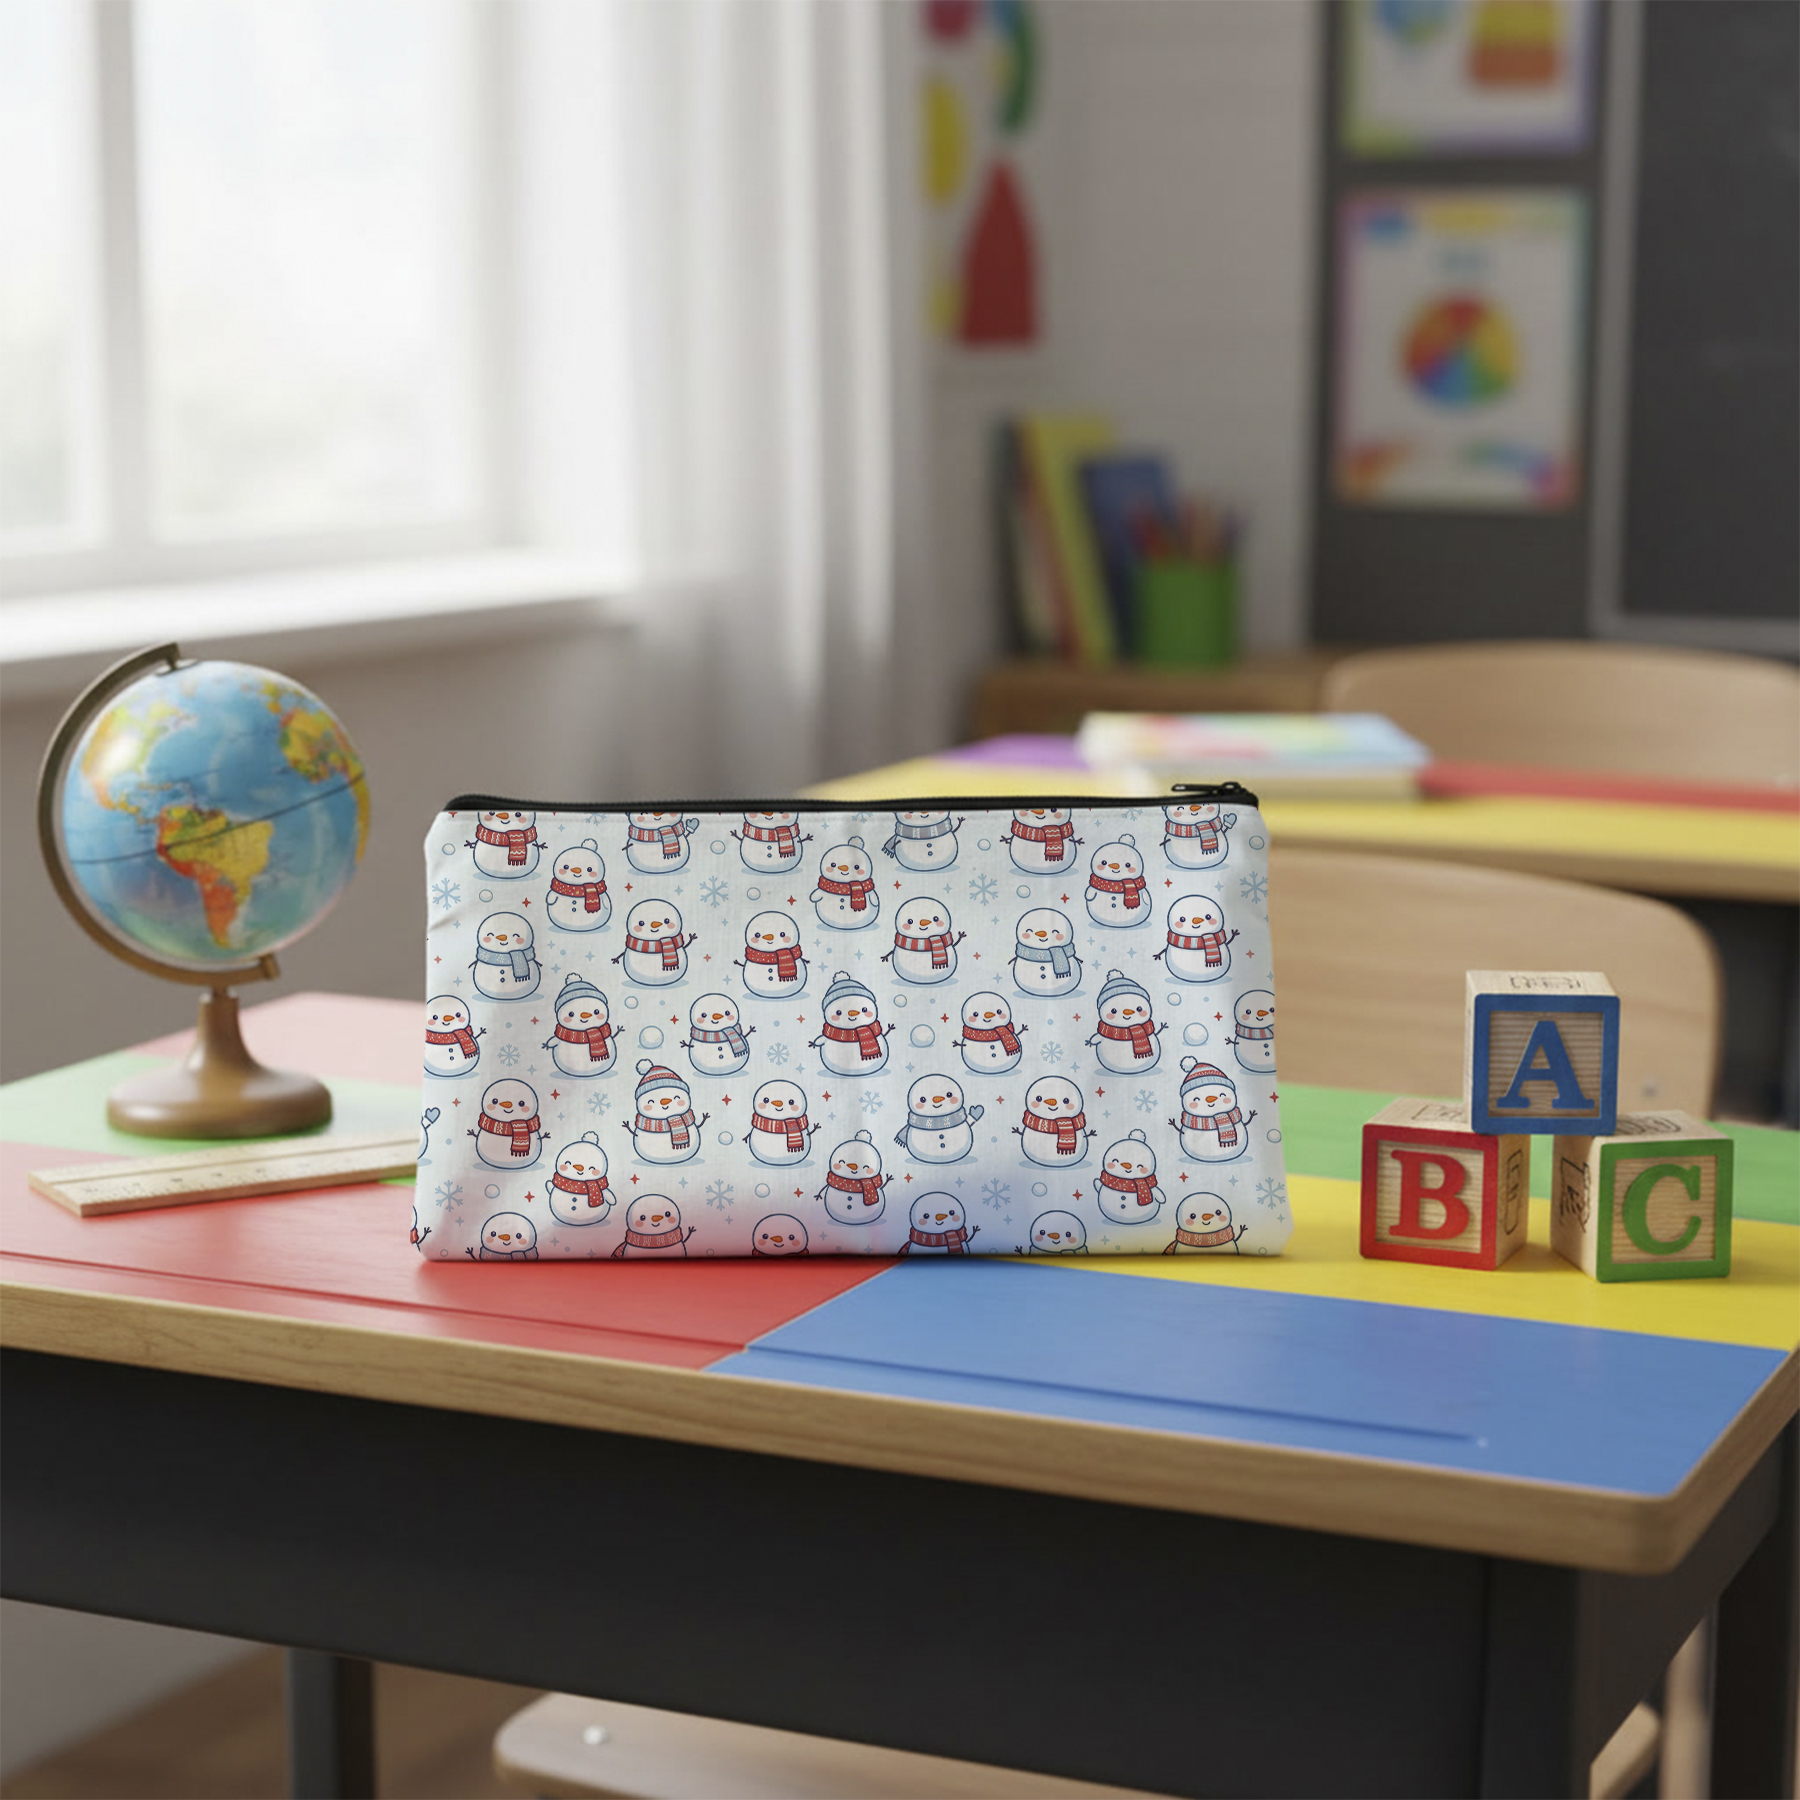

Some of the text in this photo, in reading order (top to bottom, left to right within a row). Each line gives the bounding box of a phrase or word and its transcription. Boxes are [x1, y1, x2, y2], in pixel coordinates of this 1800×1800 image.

[1497, 1020, 1595, 1110] A
[1389, 1149, 1469, 1241] B
[1622, 1163, 1702, 1256] C
